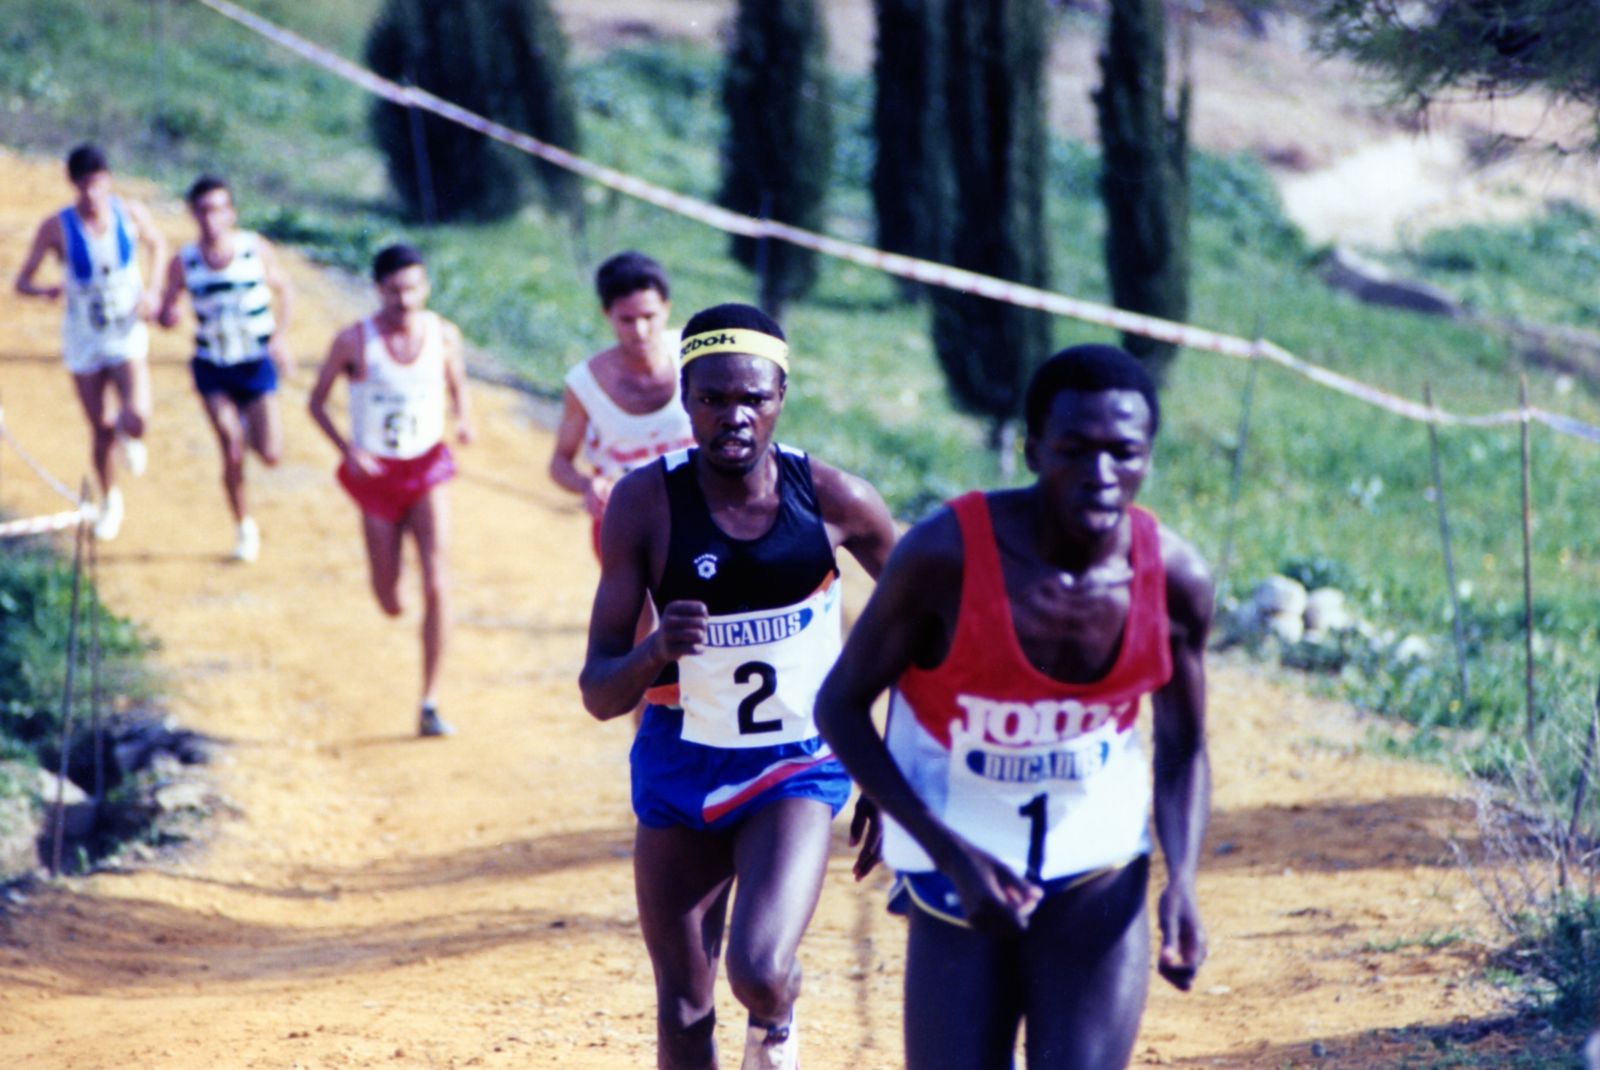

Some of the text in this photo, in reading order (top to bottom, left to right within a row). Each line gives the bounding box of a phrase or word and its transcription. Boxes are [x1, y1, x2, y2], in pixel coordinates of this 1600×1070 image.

[680, 333, 736, 358] ebok
[733, 660, 784, 736] 2
[1018, 792, 1049, 881] 1
